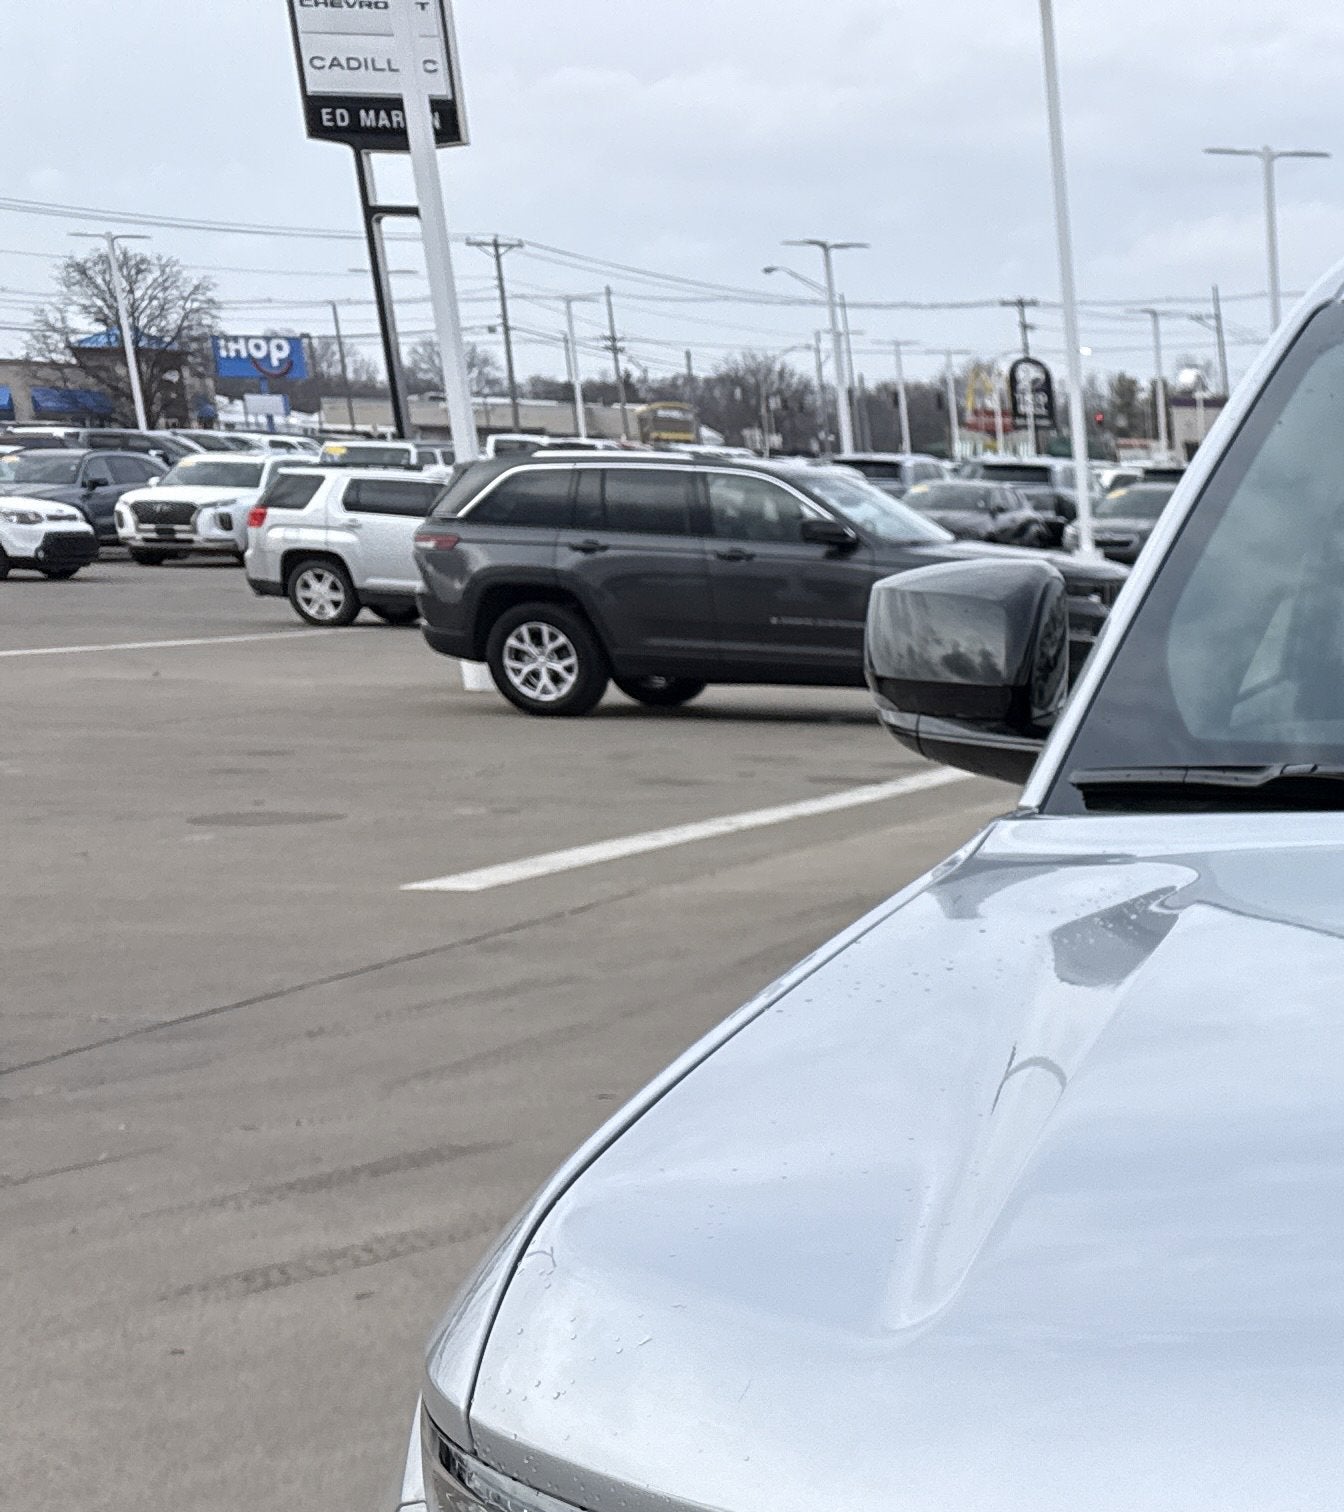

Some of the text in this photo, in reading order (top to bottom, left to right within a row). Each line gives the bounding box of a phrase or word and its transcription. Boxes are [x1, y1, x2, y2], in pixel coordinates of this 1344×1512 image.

[299, 0, 430, 11] CHEVROT
[309, 55, 439, 74] CADILLC
[321, 107, 442, 130] ED MARN
